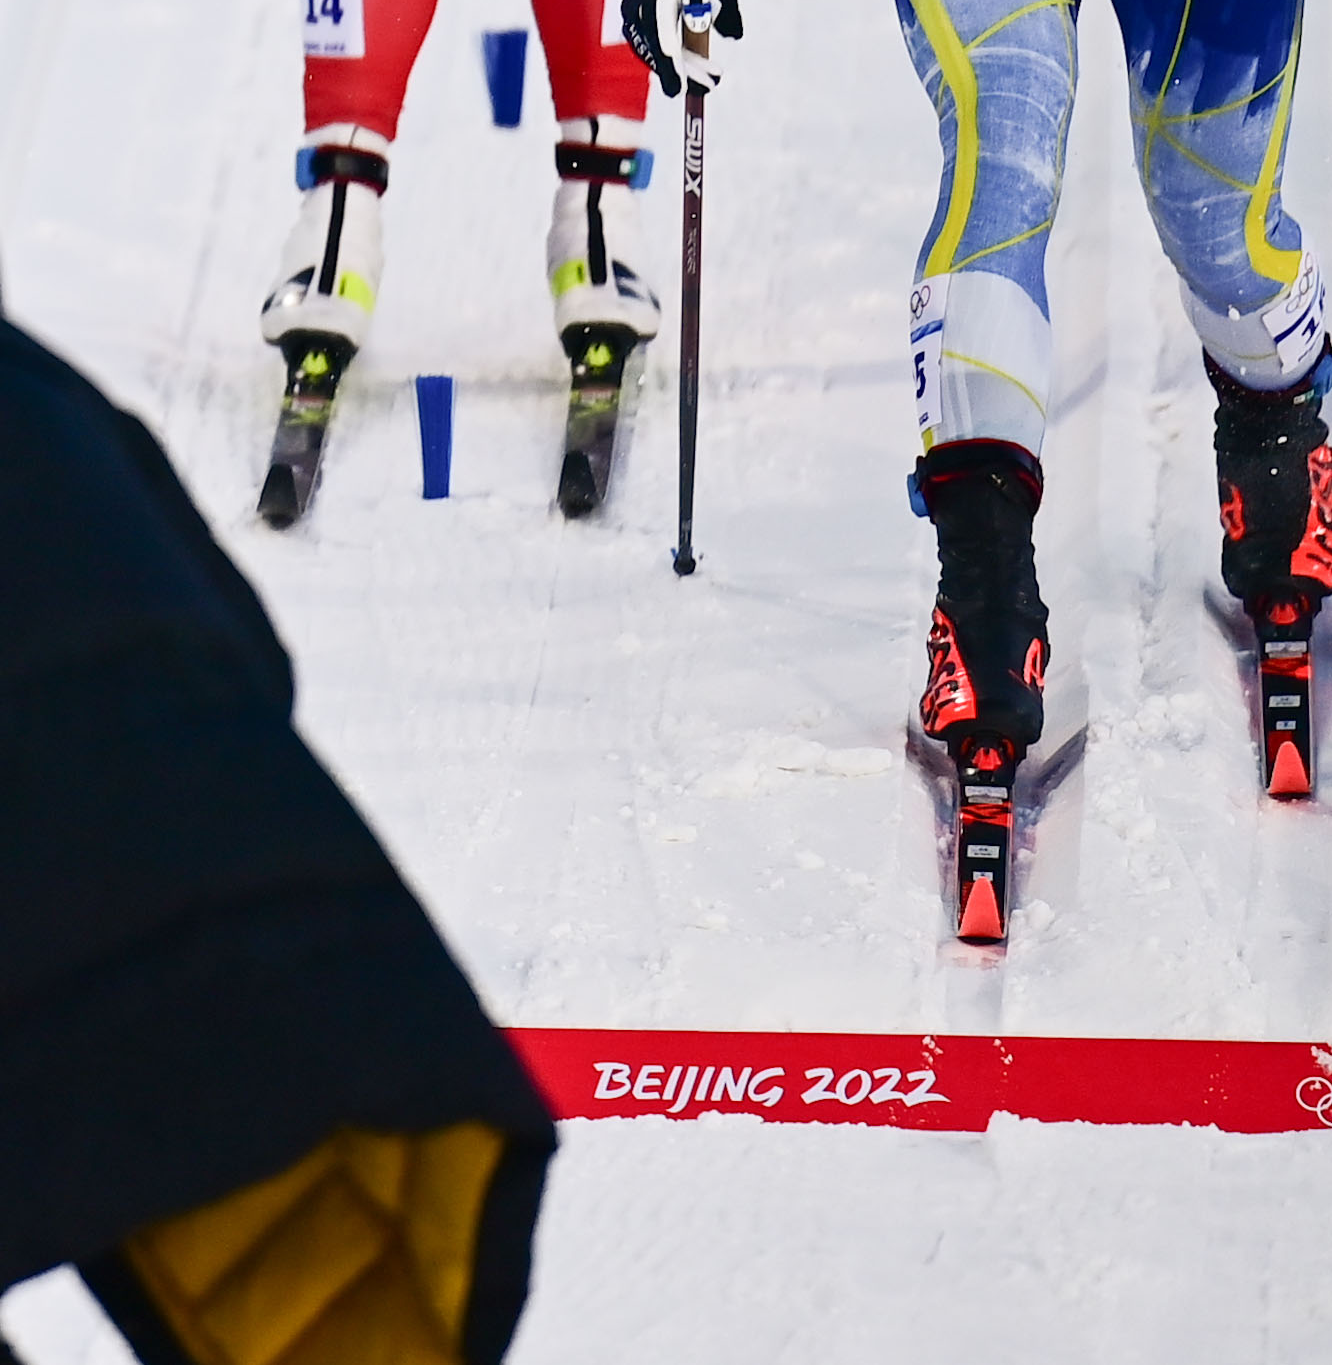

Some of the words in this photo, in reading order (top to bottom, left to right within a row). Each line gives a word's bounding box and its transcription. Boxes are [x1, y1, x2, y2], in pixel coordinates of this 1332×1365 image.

[685, 114, 703, 199] SWIX
[912, 350, 927, 400] 5
[592, 1062, 785, 1114] BEIJING
[801, 1067, 951, 1107] 2022
